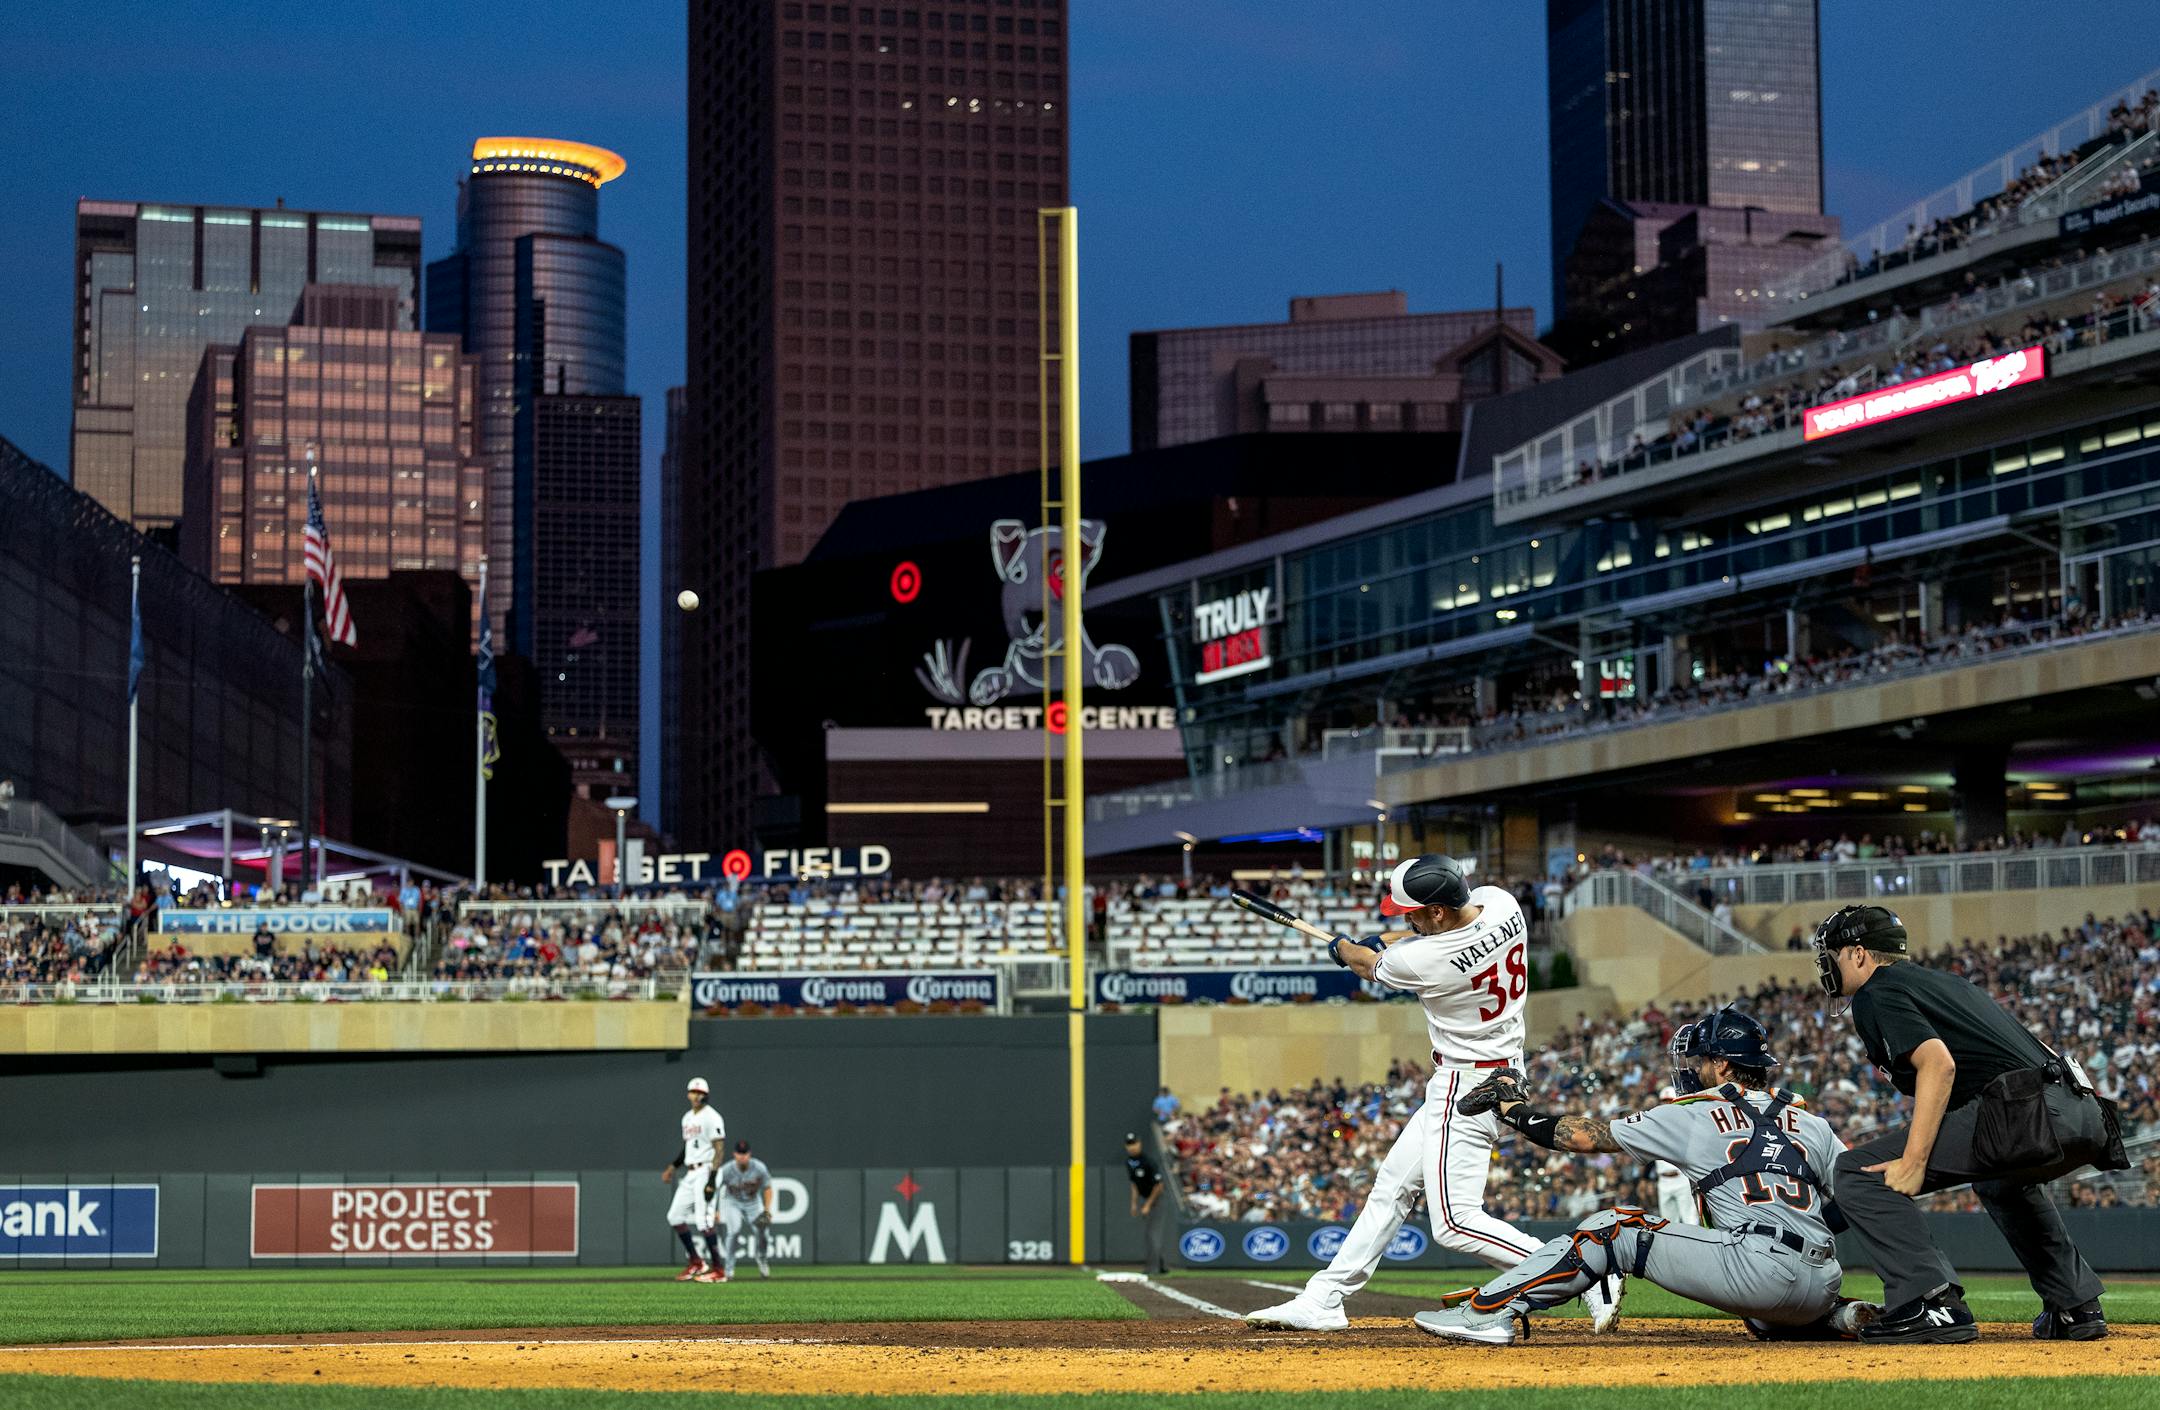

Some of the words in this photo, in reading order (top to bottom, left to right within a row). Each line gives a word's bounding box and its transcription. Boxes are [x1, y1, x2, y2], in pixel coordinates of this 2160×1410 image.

[1194, 586, 1271, 642] TRULY
[925, 706, 1043, 730] TARGET
[764, 845, 892, 878] FIELD
[197, 914, 257, 932] THE
[268, 914, 353, 932] DOCK
[1449, 911, 1524, 974] WALLNER
[695, 978, 780, 1006] Corona
[801, 977, 886, 1006] Corona
[907, 976, 992, 1005] Corona
[1100, 972, 1188, 1001] Corona
[1230, 972, 1317, 1000] Corona
[1470, 942, 1527, 1022] 38
[1709, 1104, 1802, 1134] HAE
[0, 1190, 100, 1237] ank
[332, 1189, 492, 1219] PROJECT
[330, 1221, 494, 1251] SUCCESS
[1008, 1240, 1054, 1260] 328
[1189, 1233, 1218, 1256] Ford
[1252, 1232, 1282, 1255] Ford
